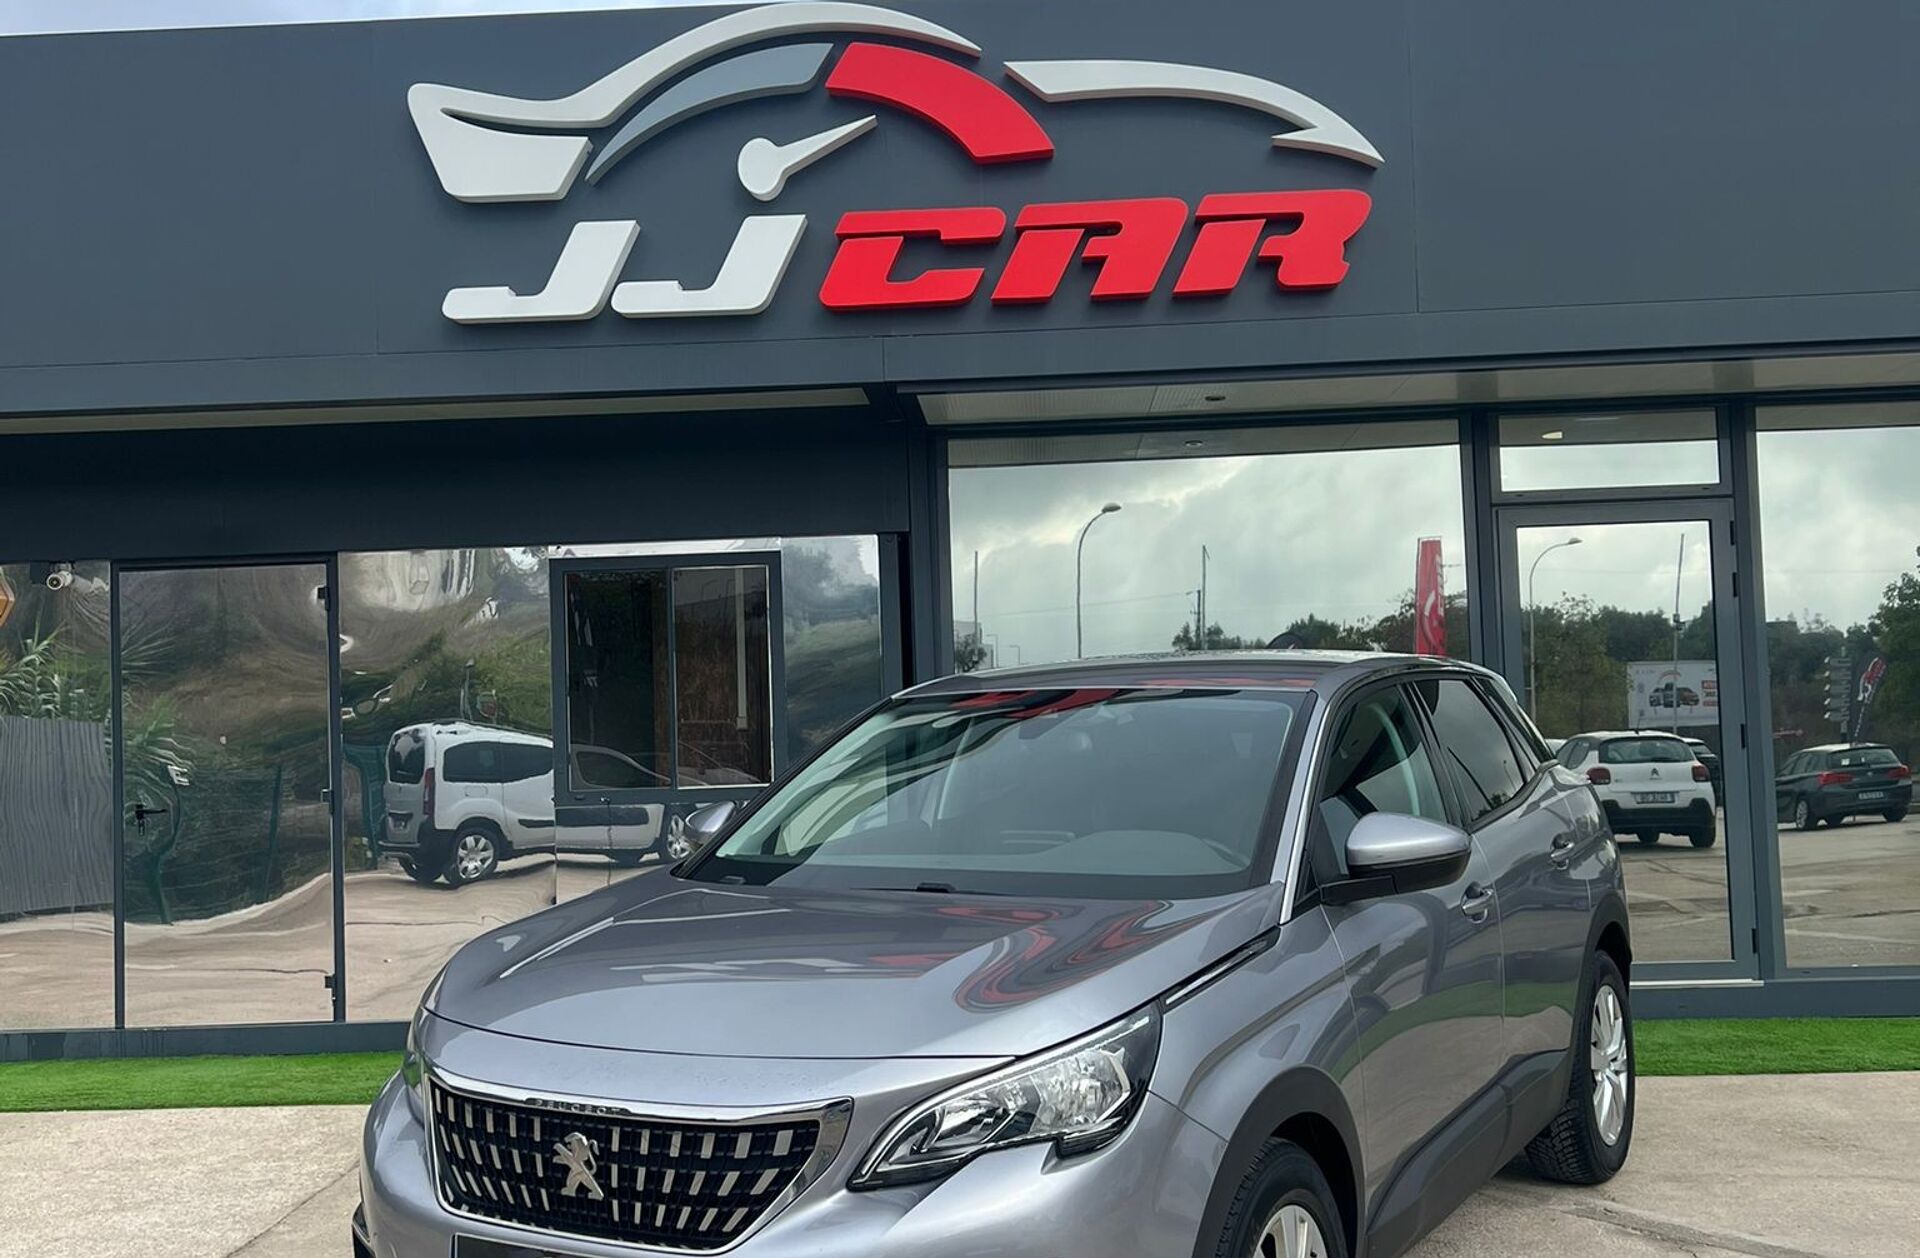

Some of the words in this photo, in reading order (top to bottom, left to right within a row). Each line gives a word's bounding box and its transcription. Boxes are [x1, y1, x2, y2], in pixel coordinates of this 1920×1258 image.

[442, 214, 807, 323] JJ
[819, 189, 1373, 310] CAR
[535, 1099, 620, 1115] PEUGEOT
